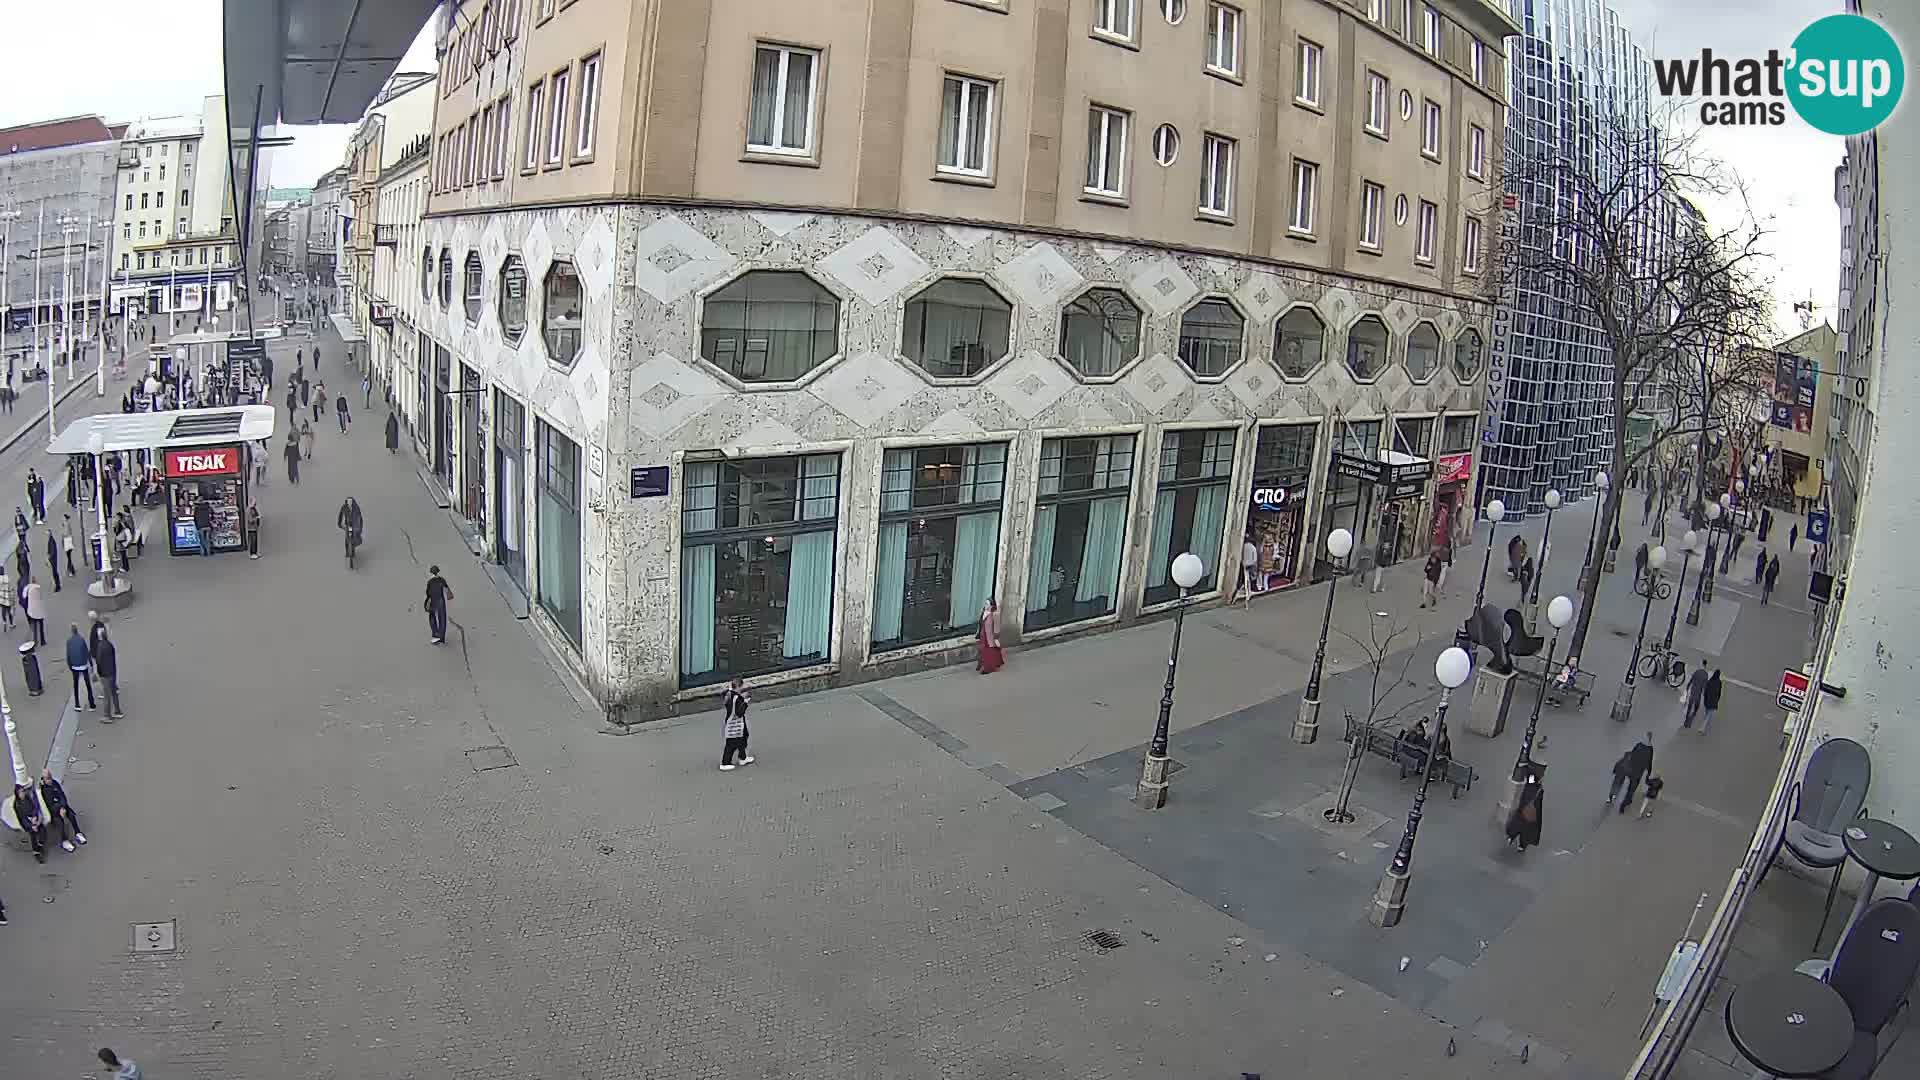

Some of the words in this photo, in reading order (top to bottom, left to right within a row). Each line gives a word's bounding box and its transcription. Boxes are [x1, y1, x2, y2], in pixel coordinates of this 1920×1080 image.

[1482, 309, 1509, 443] DUBROVNIK
[177, 453, 227, 472] TISAK
[1253, 488, 1285, 504] CRO
